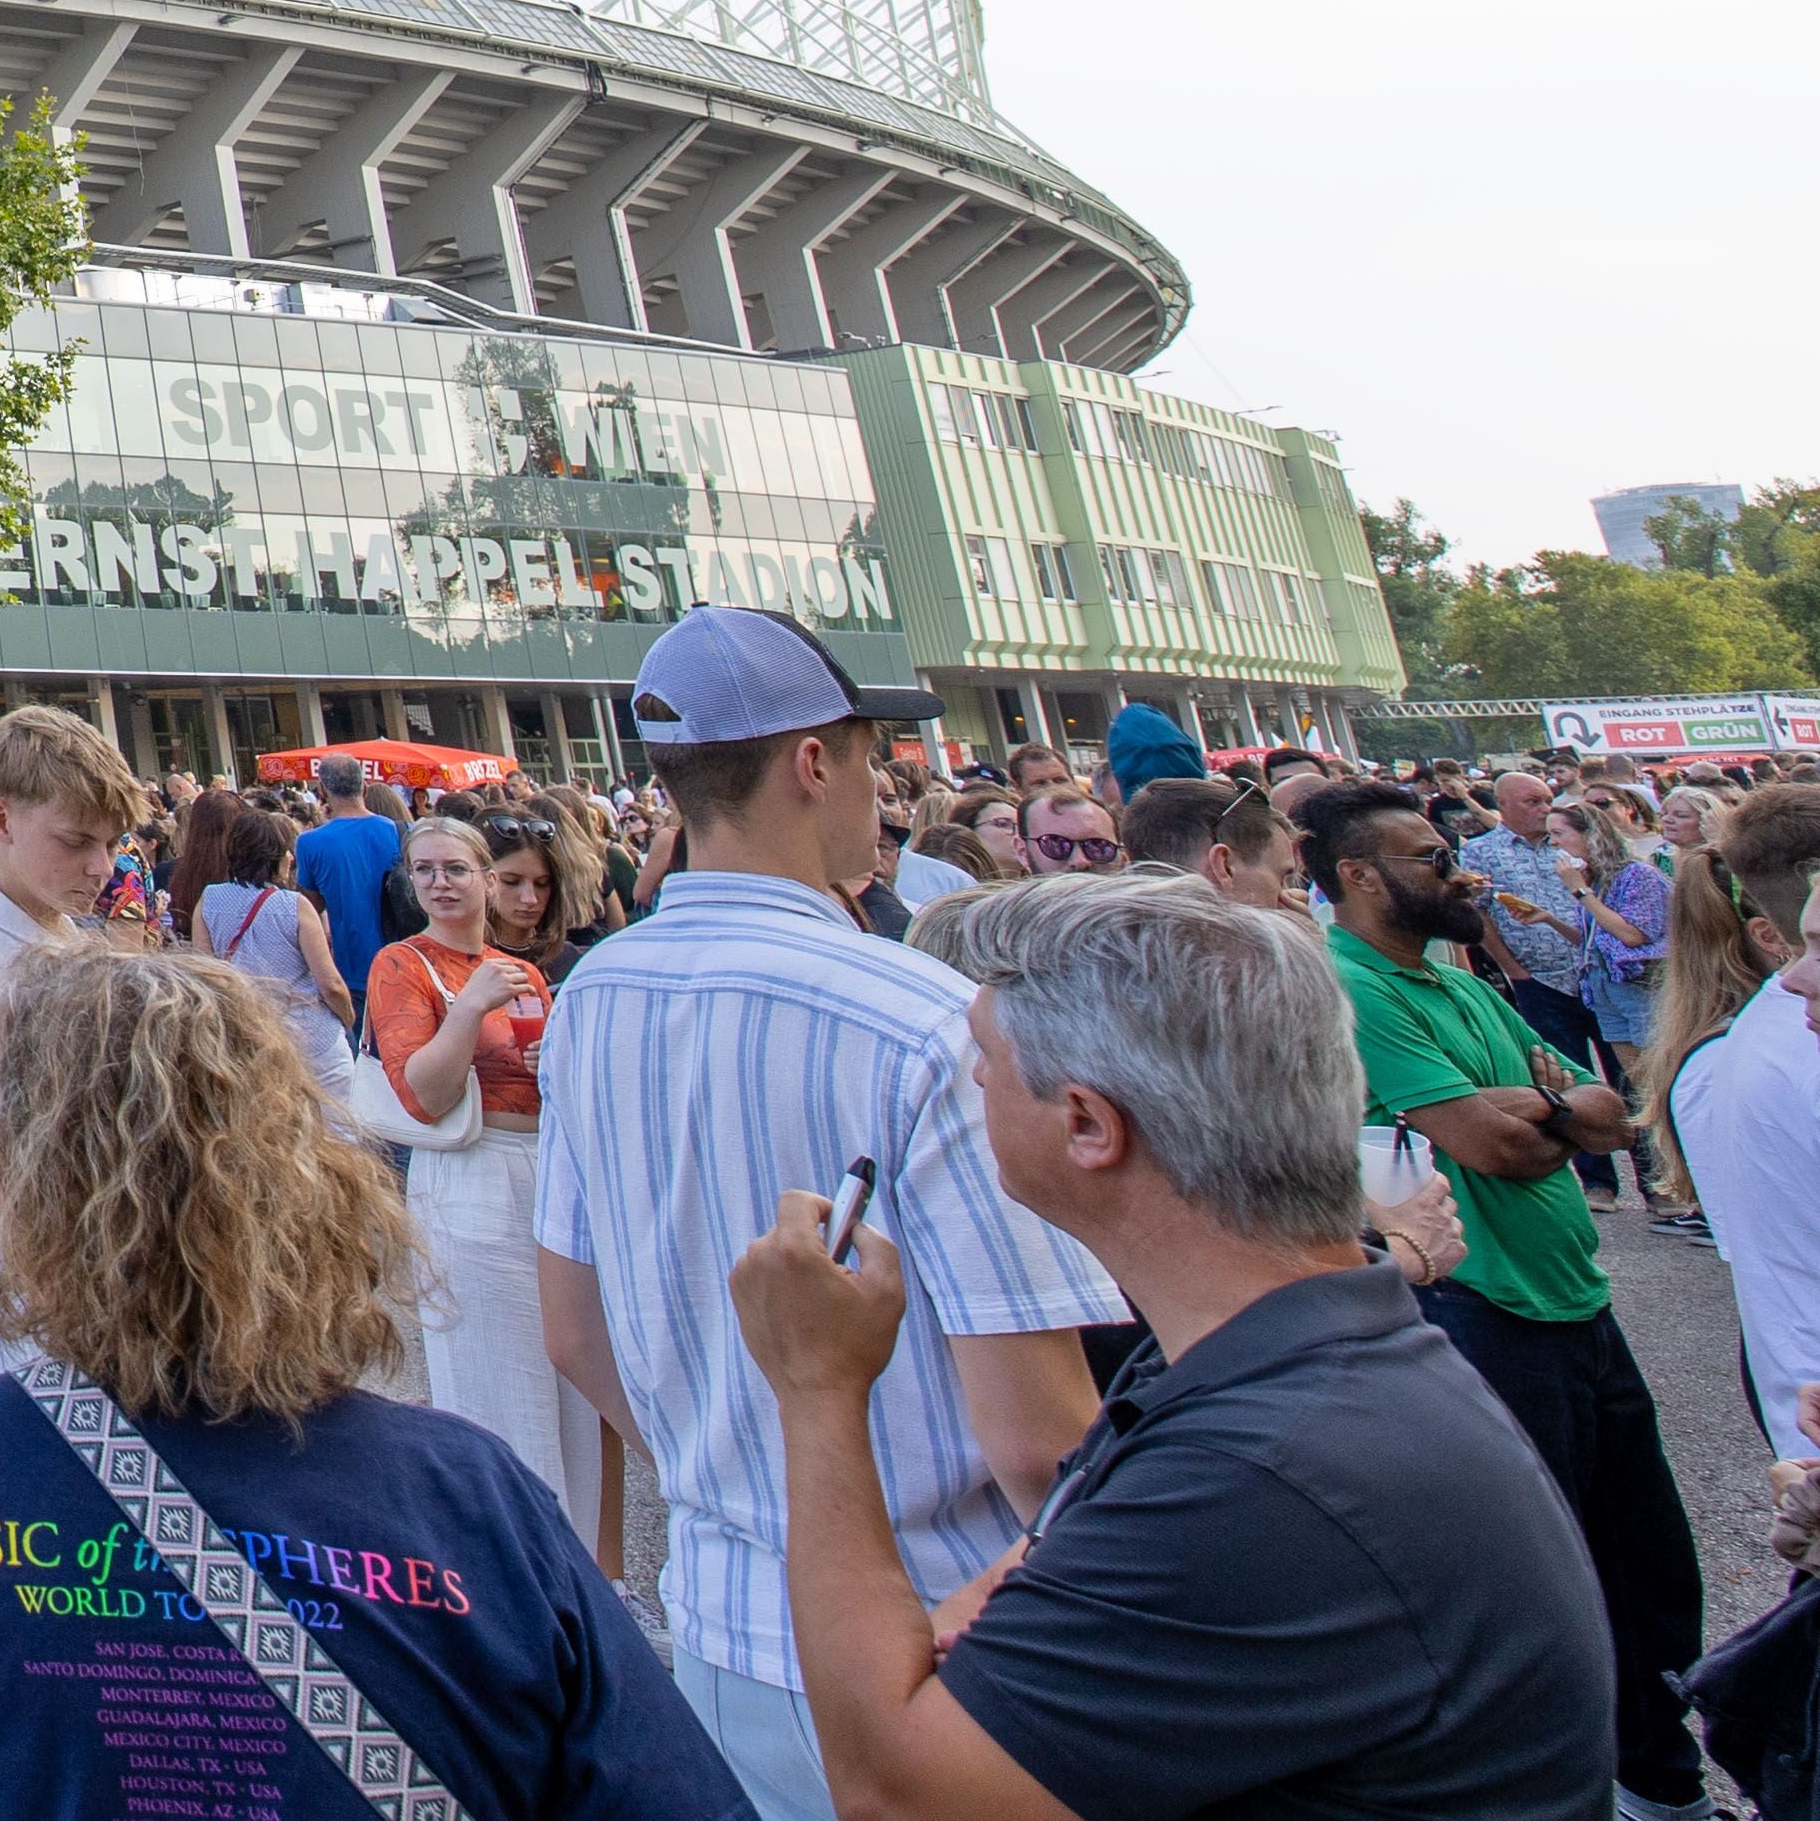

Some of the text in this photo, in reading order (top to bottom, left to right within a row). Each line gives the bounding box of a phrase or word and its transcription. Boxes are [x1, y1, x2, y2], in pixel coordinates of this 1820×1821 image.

[169, 377, 728, 477] SPORT WIEN
[295, 529, 603, 608] HAPPEL
[615, 543, 893, 621] STADION
[1598, 703, 1757, 719] EINGANG STEHPLÄTZE
[1620, 721, 1759, 742] ROT GRÜN
[310, 758, 384, 780] BEL
[462, 758, 504, 782] BREZEL
[77, 1522, 129, 1586] of
[14, 1584, 147, 1619] WORLD
[286, 1598, 344, 1630] 022
[95, 1640, 126, 1658] SAN
[129, 1643, 170, 1660] JOSE,
[172, 1644, 226, 1661] COSTA
[23, 1660, 259, 1685] SANTO DOMINGO, DOMINICA
[101, 1687, 276, 1709] MONTERREY, MEXICO
[97, 1710, 287, 1732] GUADALAJARA, MEXICO
[104, 1732, 287, 1755] MEXICO CITY, MEXICO
[129, 1753, 195, 1772] DALLAS,
[197, 1757, 222, 1773] TX
[234, 1760, 267, 1777] USA
[119, 1775, 209, 1795] HOUSTON,
[212, 1780, 235, 1796] TX
[249, 1783, 283, 1800] USA
[127, 1797, 209, 1817] PHOENIX,
[213, 1803, 235, 1819] AZ
[247, 1806, 281, 1821] USA
